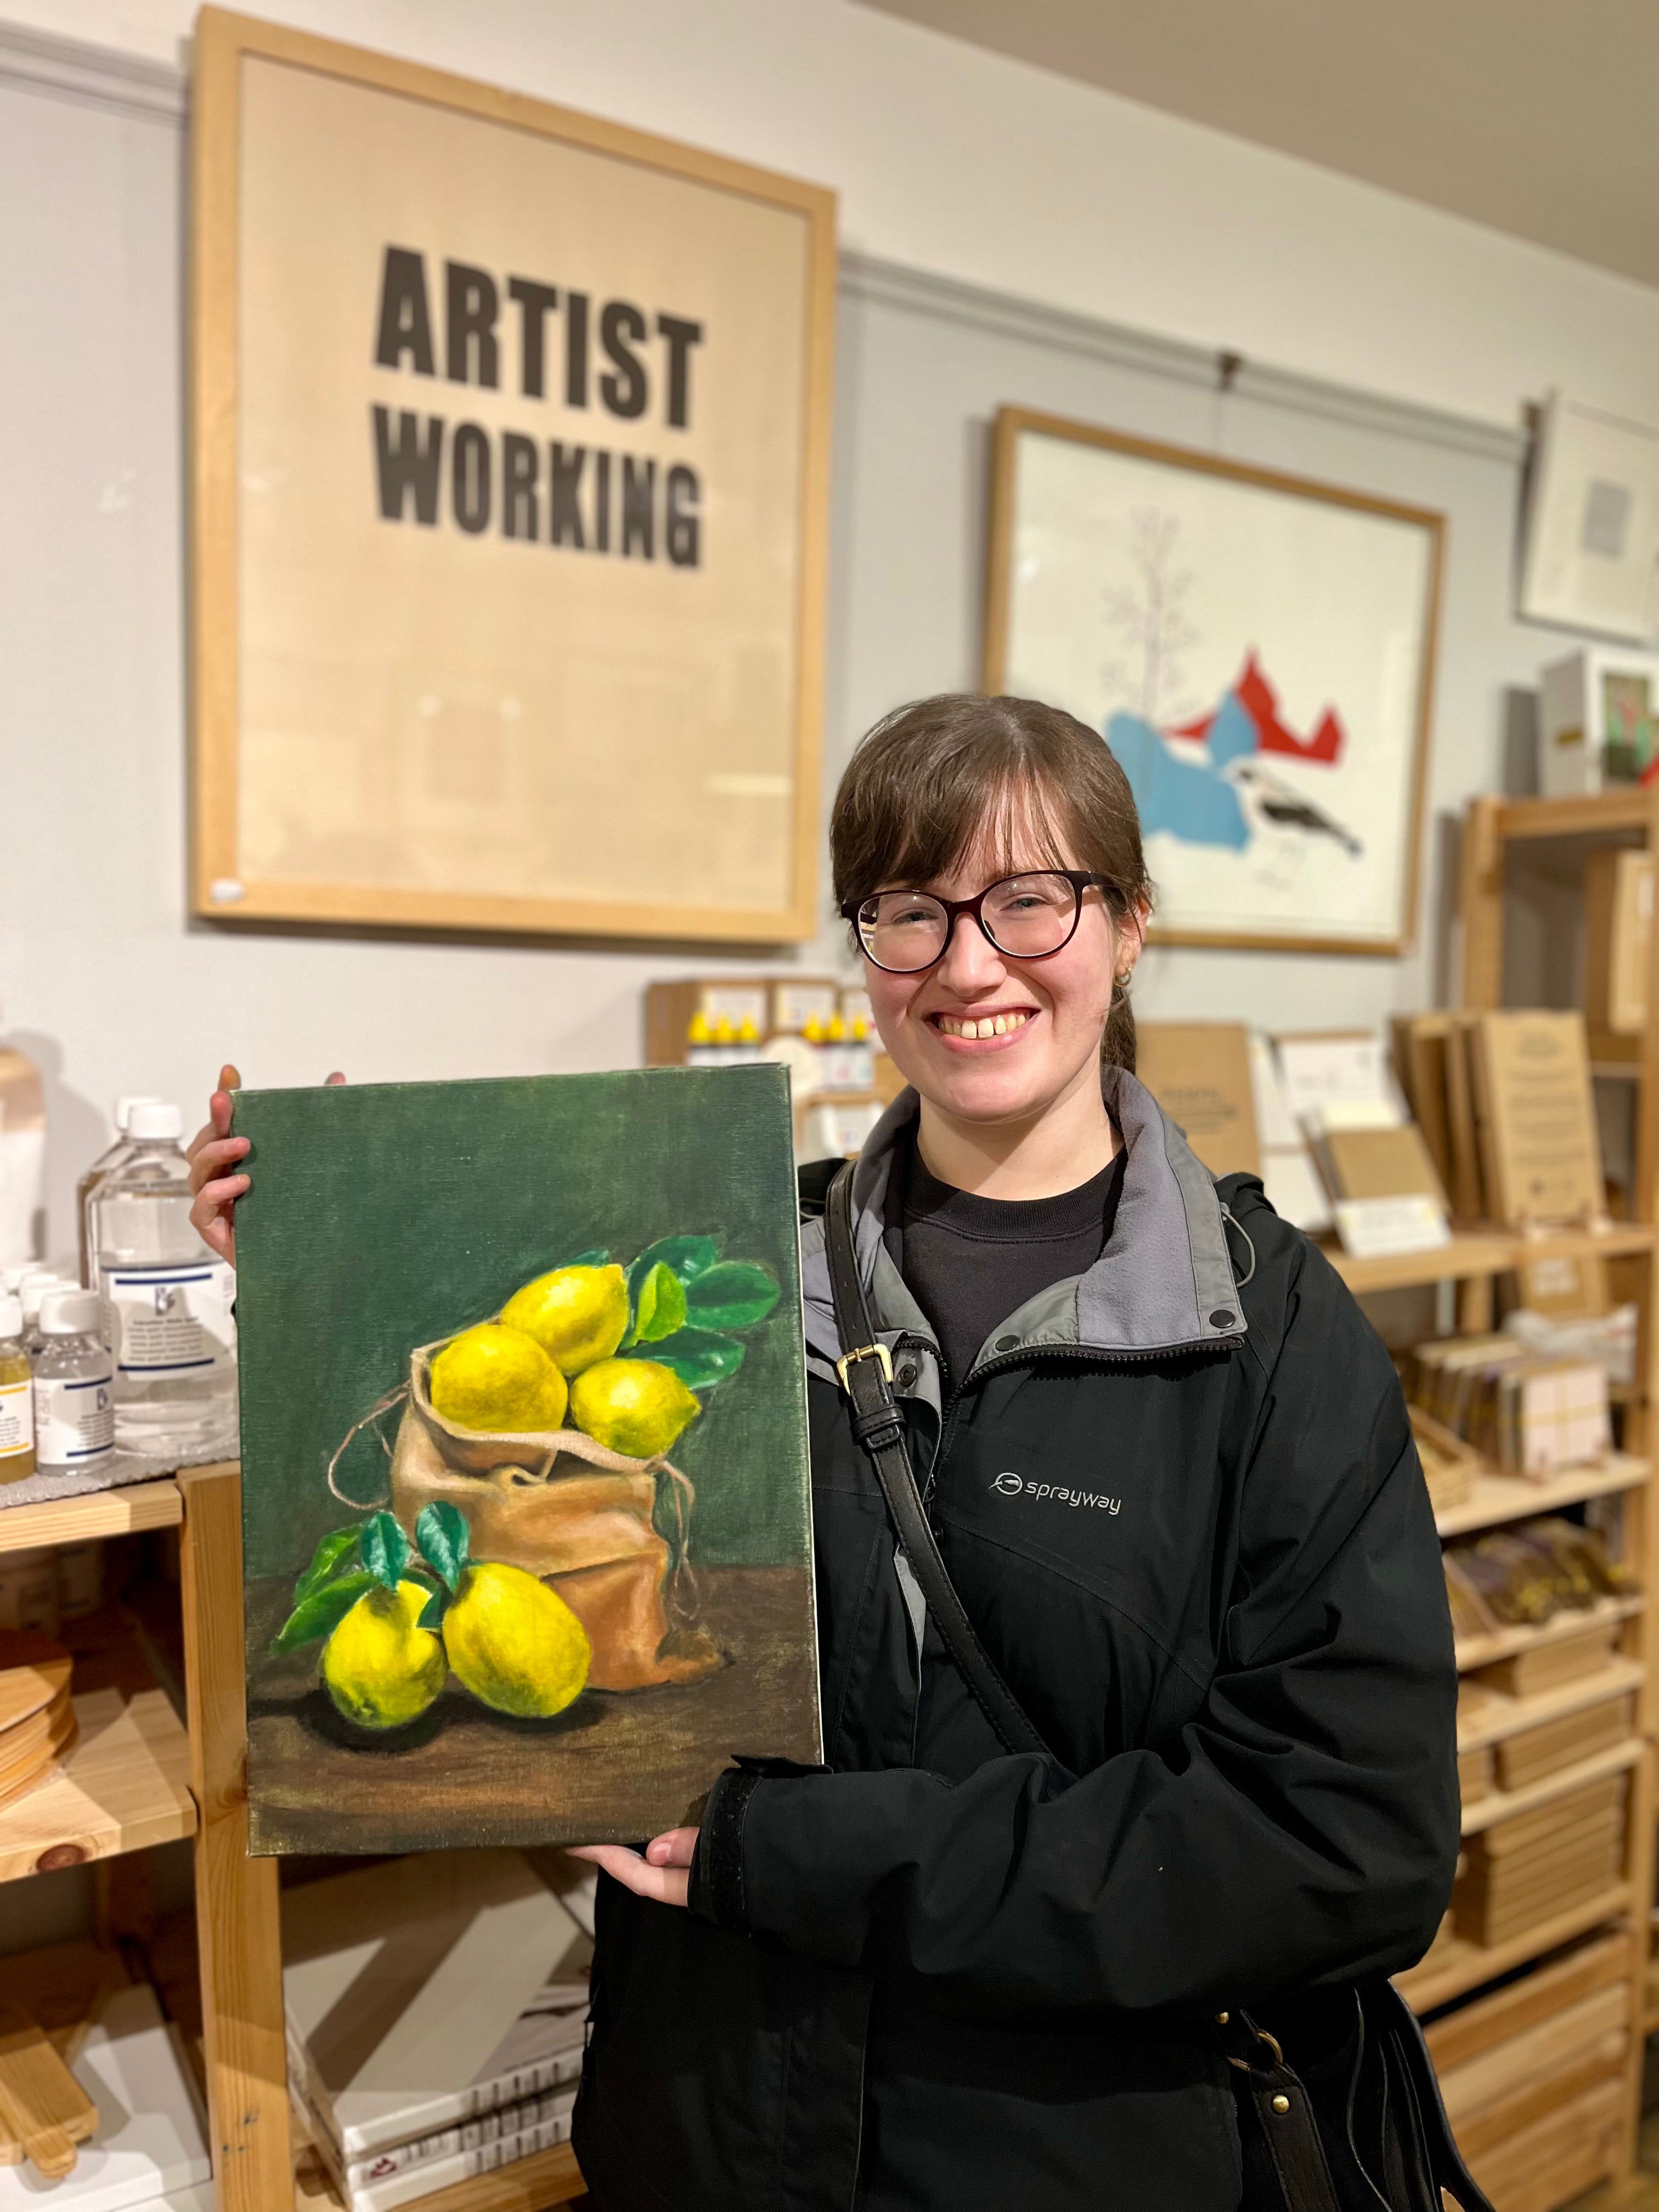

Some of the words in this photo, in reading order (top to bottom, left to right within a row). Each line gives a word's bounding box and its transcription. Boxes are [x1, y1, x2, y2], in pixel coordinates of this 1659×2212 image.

[374, 244, 703, 430] ARTIST
[371, 404, 700, 569] WORKING
[1024, 1481, 1122, 1516] sprayway
